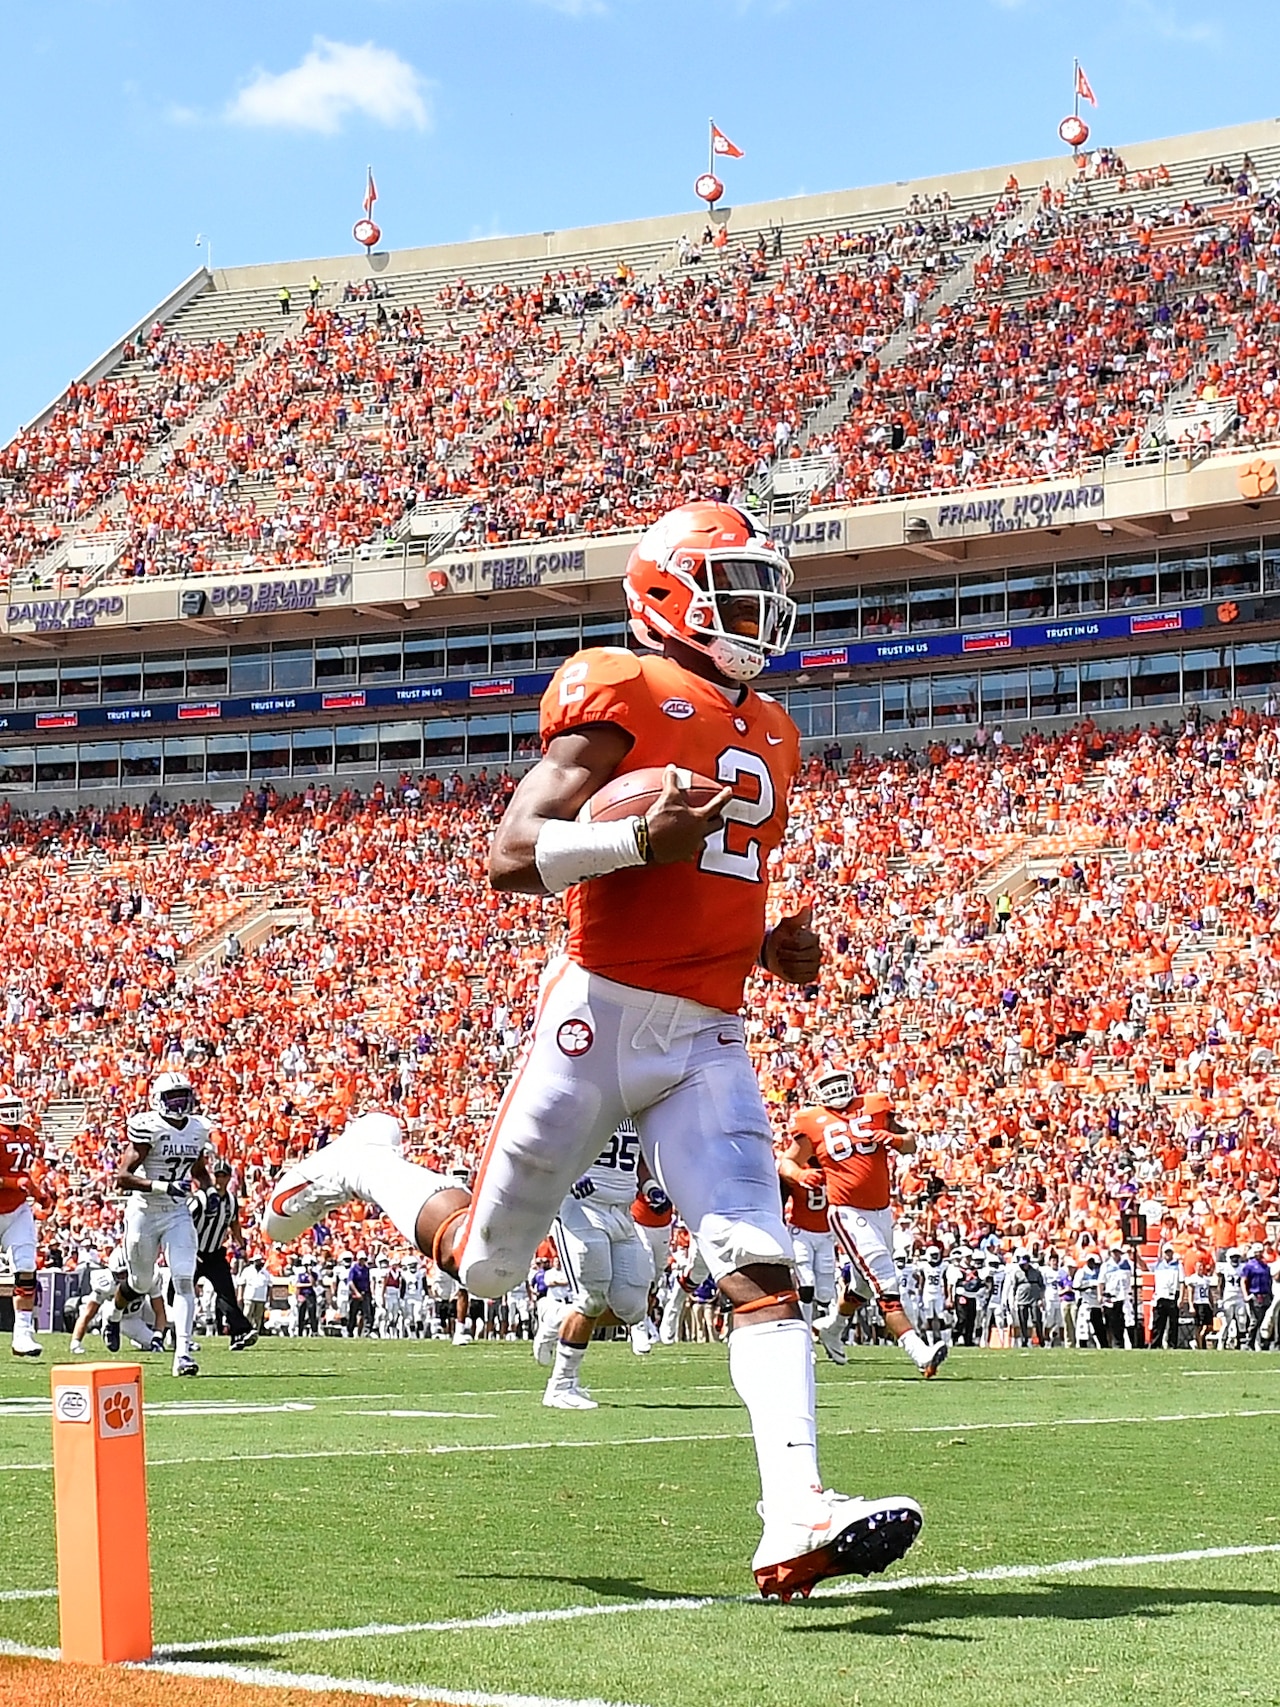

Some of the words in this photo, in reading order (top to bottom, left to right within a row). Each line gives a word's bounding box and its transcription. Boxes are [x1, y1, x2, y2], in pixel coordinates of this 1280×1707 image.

[938, 499, 1005, 527] FRANK
[1014, 484, 1105, 516] HOWARD
[768, 520, 842, 545] FULLER
[480, 556, 528, 580] FRED
[535, 550, 585, 575] CONE
[211, 585, 253, 606] BOB
[257, 574, 351, 601] BRADLEY
[6, 600, 70, 623] DANNY
[73, 595, 124, 616] FORD
[1046, 627, 1073, 639] TRUST
[1074, 626, 1086, 636] IN
[1086, 624, 1099, 634] US
[877, 646, 903, 656] TRUST
[905, 645, 915, 654] IN
[916, 643, 928, 653] US
[396, 689, 420, 699] TRUST
[421, 688, 431, 697] IN
[431, 687, 443, 696] US
[558, 661, 589, 706] 2
[107, 710, 130, 720] TRUST
[131, 710, 140, 718] IN
[141, 709, 152, 718] US
[251, 700, 274, 710] TRUST
[275, 700, 284, 708] IN
[285, 699, 296, 708] US
[664, 703, 689, 713] ACC
[699, 746, 775, 884] 2
[823, 1114, 878, 1162] 65
[159, 1156, 197, 1181] 37
